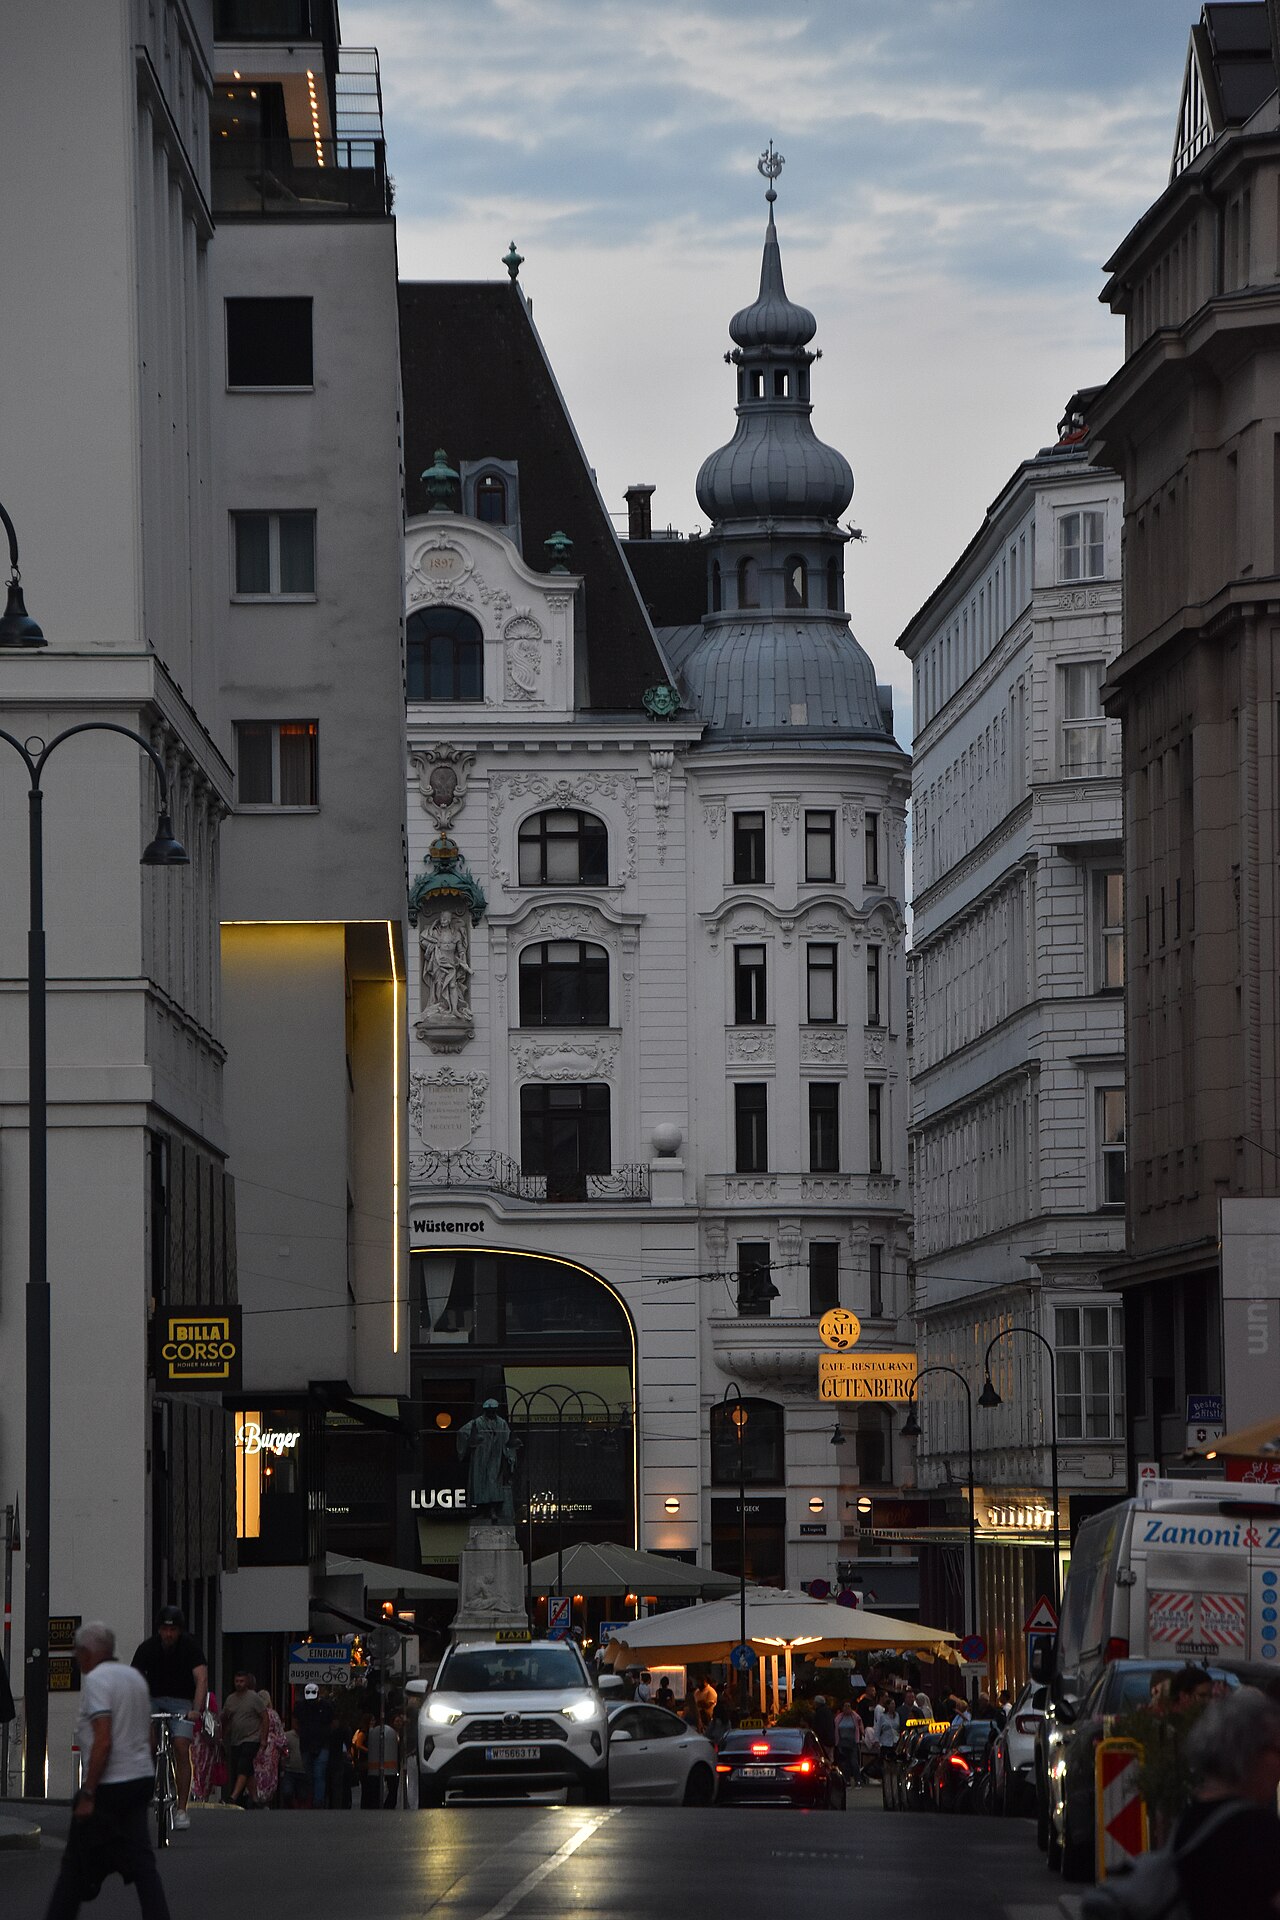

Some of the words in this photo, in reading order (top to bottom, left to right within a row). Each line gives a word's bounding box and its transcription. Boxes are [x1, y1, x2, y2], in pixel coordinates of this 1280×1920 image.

[430, 558, 455, 569] 1897
[413, 1220, 485, 1233] Wüstenrot
[176, 1326, 221, 1341] BILLA
[820, 1323, 859, 1336] CAFE
[161, 1341, 236, 1361] CORSO
[821, 1378, 915, 1398] GUTENBERG
[237, 1422, 301, 1456] Burger
[410, 1489, 478, 1509] LUGE
[1143, 1519, 1242, 1548] Zanoni
[1243, 1527, 1263, 1549] &
[500, 1631, 527, 1639] TAXI
[309, 1649, 344, 1658] EINBAHN
[290, 1670, 322, 1680] ausgen.
